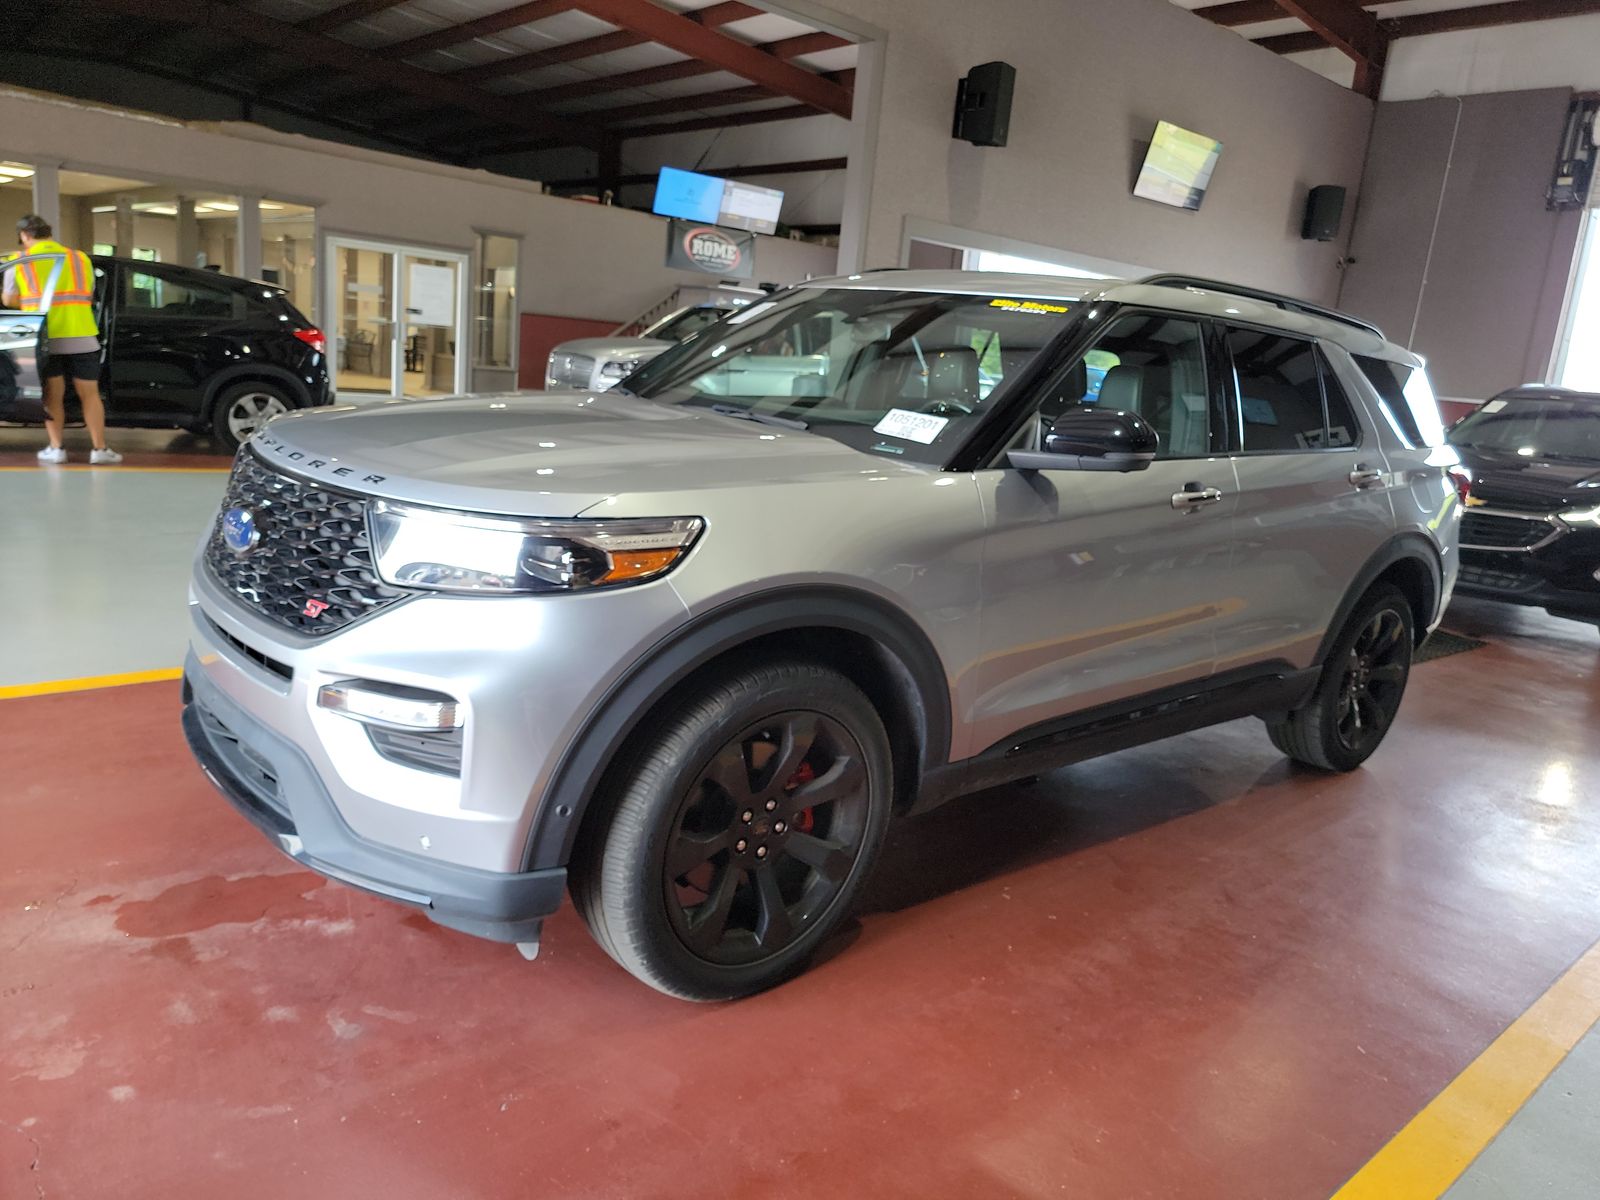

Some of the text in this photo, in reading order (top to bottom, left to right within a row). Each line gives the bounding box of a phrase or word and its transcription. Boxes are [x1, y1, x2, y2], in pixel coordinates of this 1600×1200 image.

[692, 238, 737, 259] ROME
[889, 413, 939, 430] 1051201
[303, 598, 330, 618] ST
